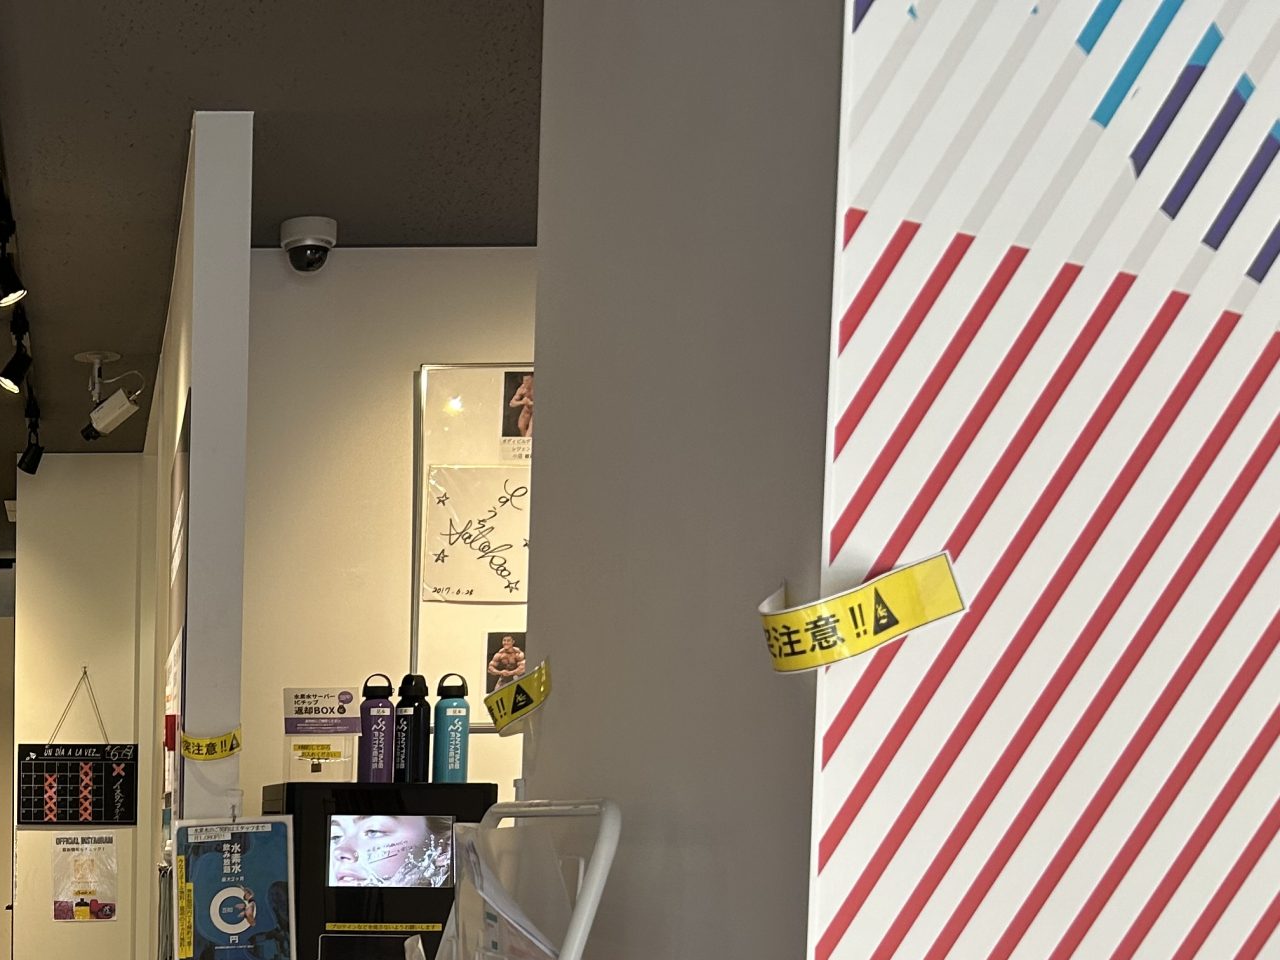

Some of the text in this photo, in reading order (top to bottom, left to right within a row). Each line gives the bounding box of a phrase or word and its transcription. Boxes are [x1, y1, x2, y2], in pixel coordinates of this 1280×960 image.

[294, 706, 335, 715] 返却BOX
[67, 748, 72, 756] A
[75, 748, 82, 756] LA
[55, 836, 113, 845] OFFICIAL INSTAGRAM
[222, 843, 231, 874] 飲み放題
[231, 843, 241, 874] 水素水
